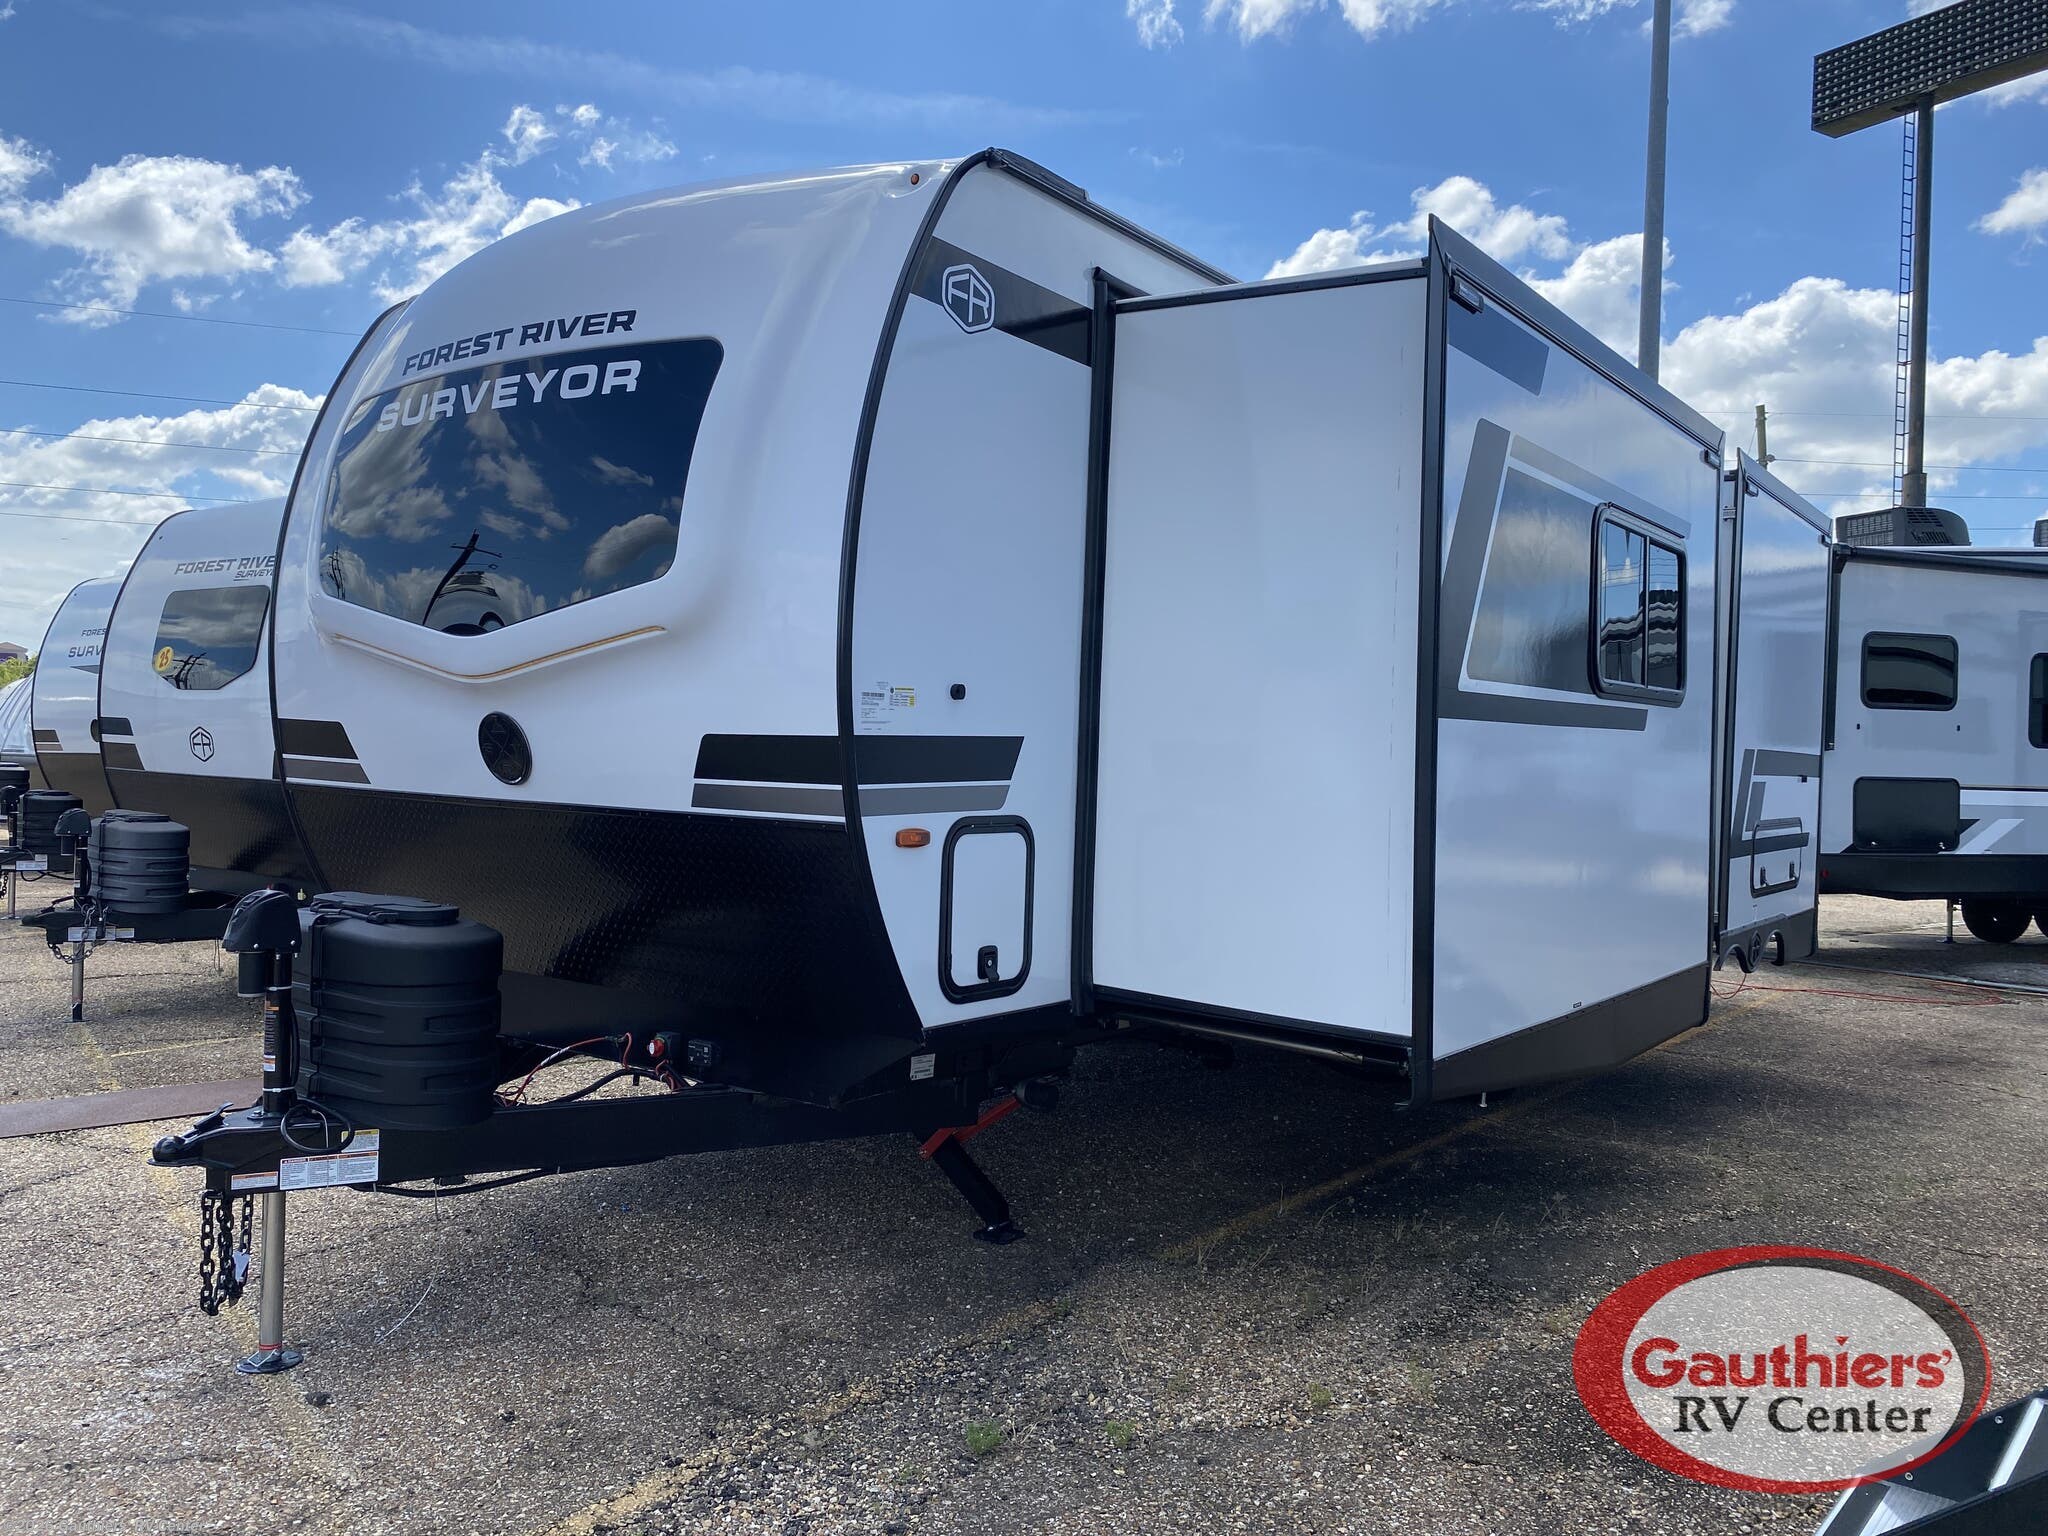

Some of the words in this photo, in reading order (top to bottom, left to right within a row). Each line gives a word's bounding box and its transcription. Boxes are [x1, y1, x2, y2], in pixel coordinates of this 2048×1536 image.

[402, 328, 515, 376] FOREST
[519, 309, 637, 346] RIVER
[376, 359, 642, 433] SURVEYOR
[174, 558, 237, 575] FOREST
[237, 555, 276, 569] RIVE
[235, 568, 273, 578] SURVEY
[81, 627, 107, 637] FORES
[68, 644, 103, 658] SURV
